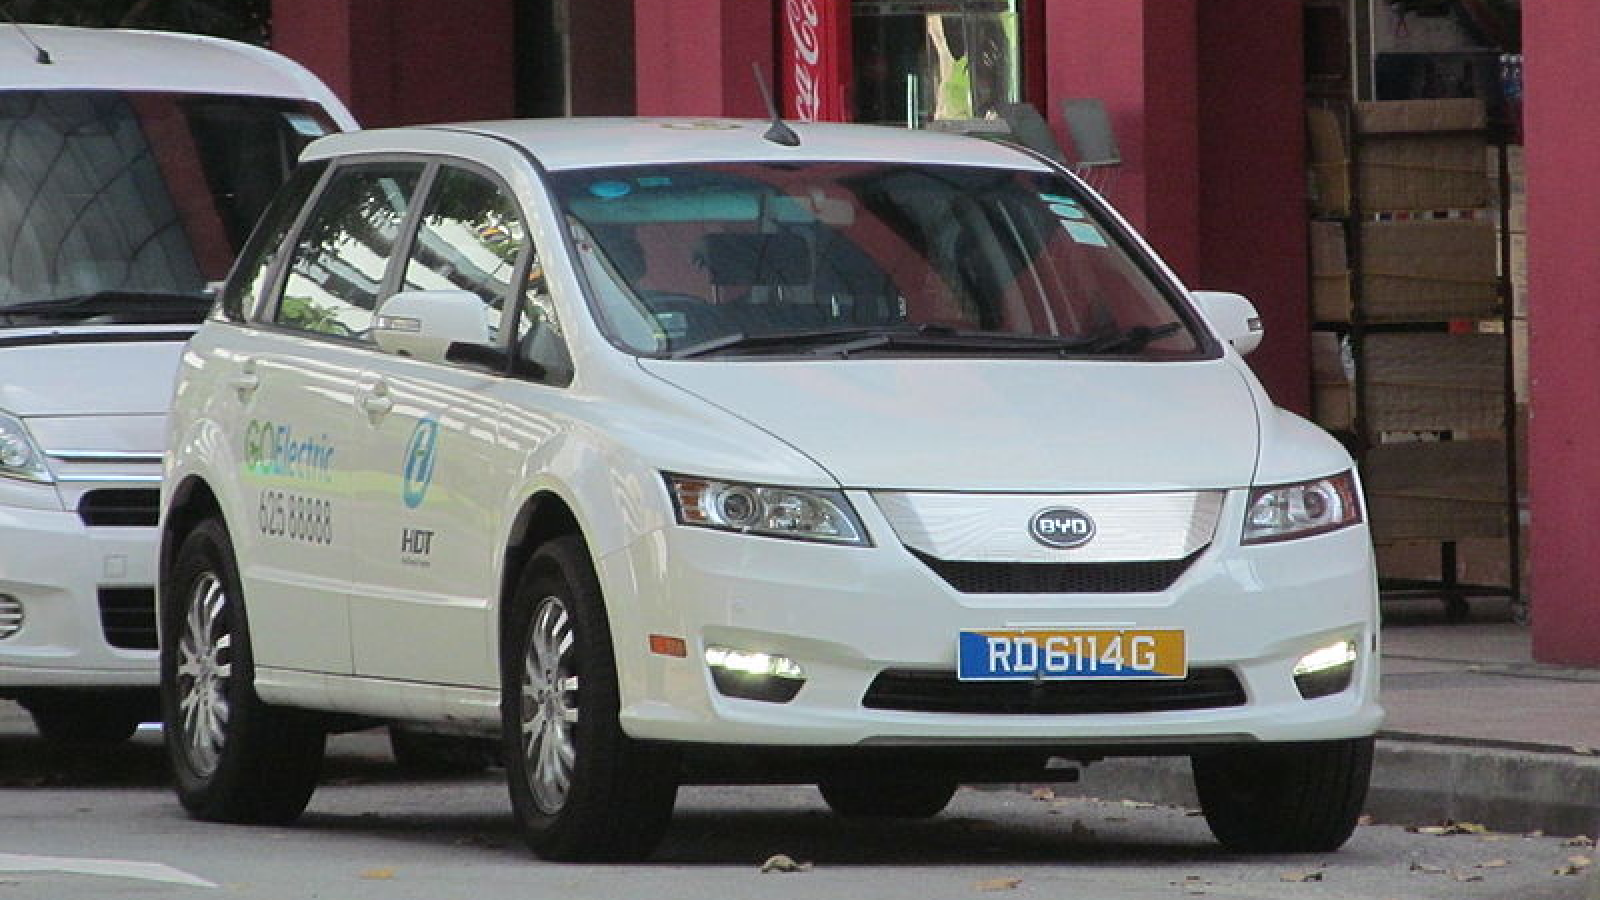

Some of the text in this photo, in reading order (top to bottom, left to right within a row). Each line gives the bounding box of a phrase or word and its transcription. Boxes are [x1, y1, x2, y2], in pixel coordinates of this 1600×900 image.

[1039, 518, 1088, 534] BYD
[401, 528, 434, 555] HDT
[987, 634, 1156, 673] RD6114G
